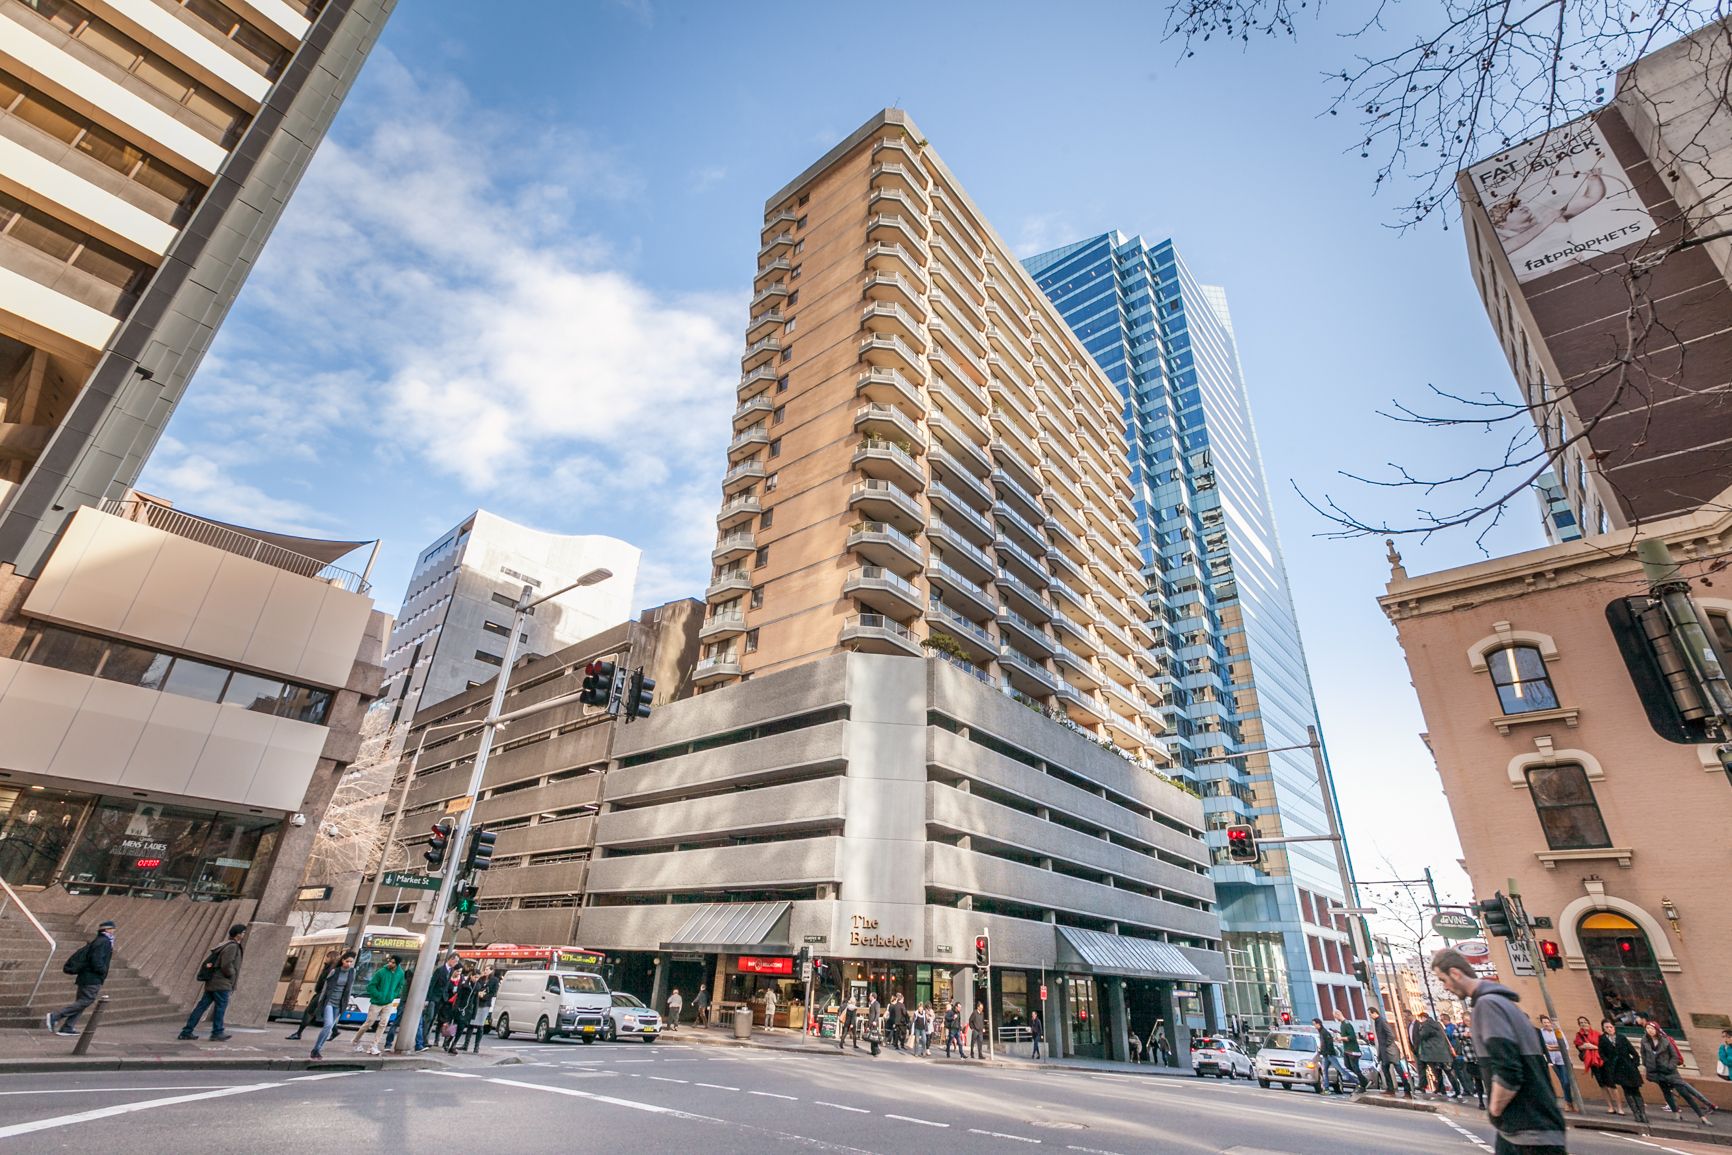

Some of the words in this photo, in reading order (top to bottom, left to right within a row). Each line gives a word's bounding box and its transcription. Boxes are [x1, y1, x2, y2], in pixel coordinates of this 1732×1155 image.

[1483, 168, 1527, 192] NEW
[1531, 138, 1599, 172] BLACK
[1479, 159, 1518, 185] FAT
[1524, 222, 1641, 271] fatPROPHETS
[122, 840, 142, 848] MENS
[143, 842, 168, 851] LADIES
[137, 859, 160, 868] OPEN
[396, 874, 421, 885] Market
[851, 914, 879, 930] The
[374, 938, 405, 948] CHARTER
[850, 931, 912, 951] Berkeley
[1512, 954, 1531, 963] WA
